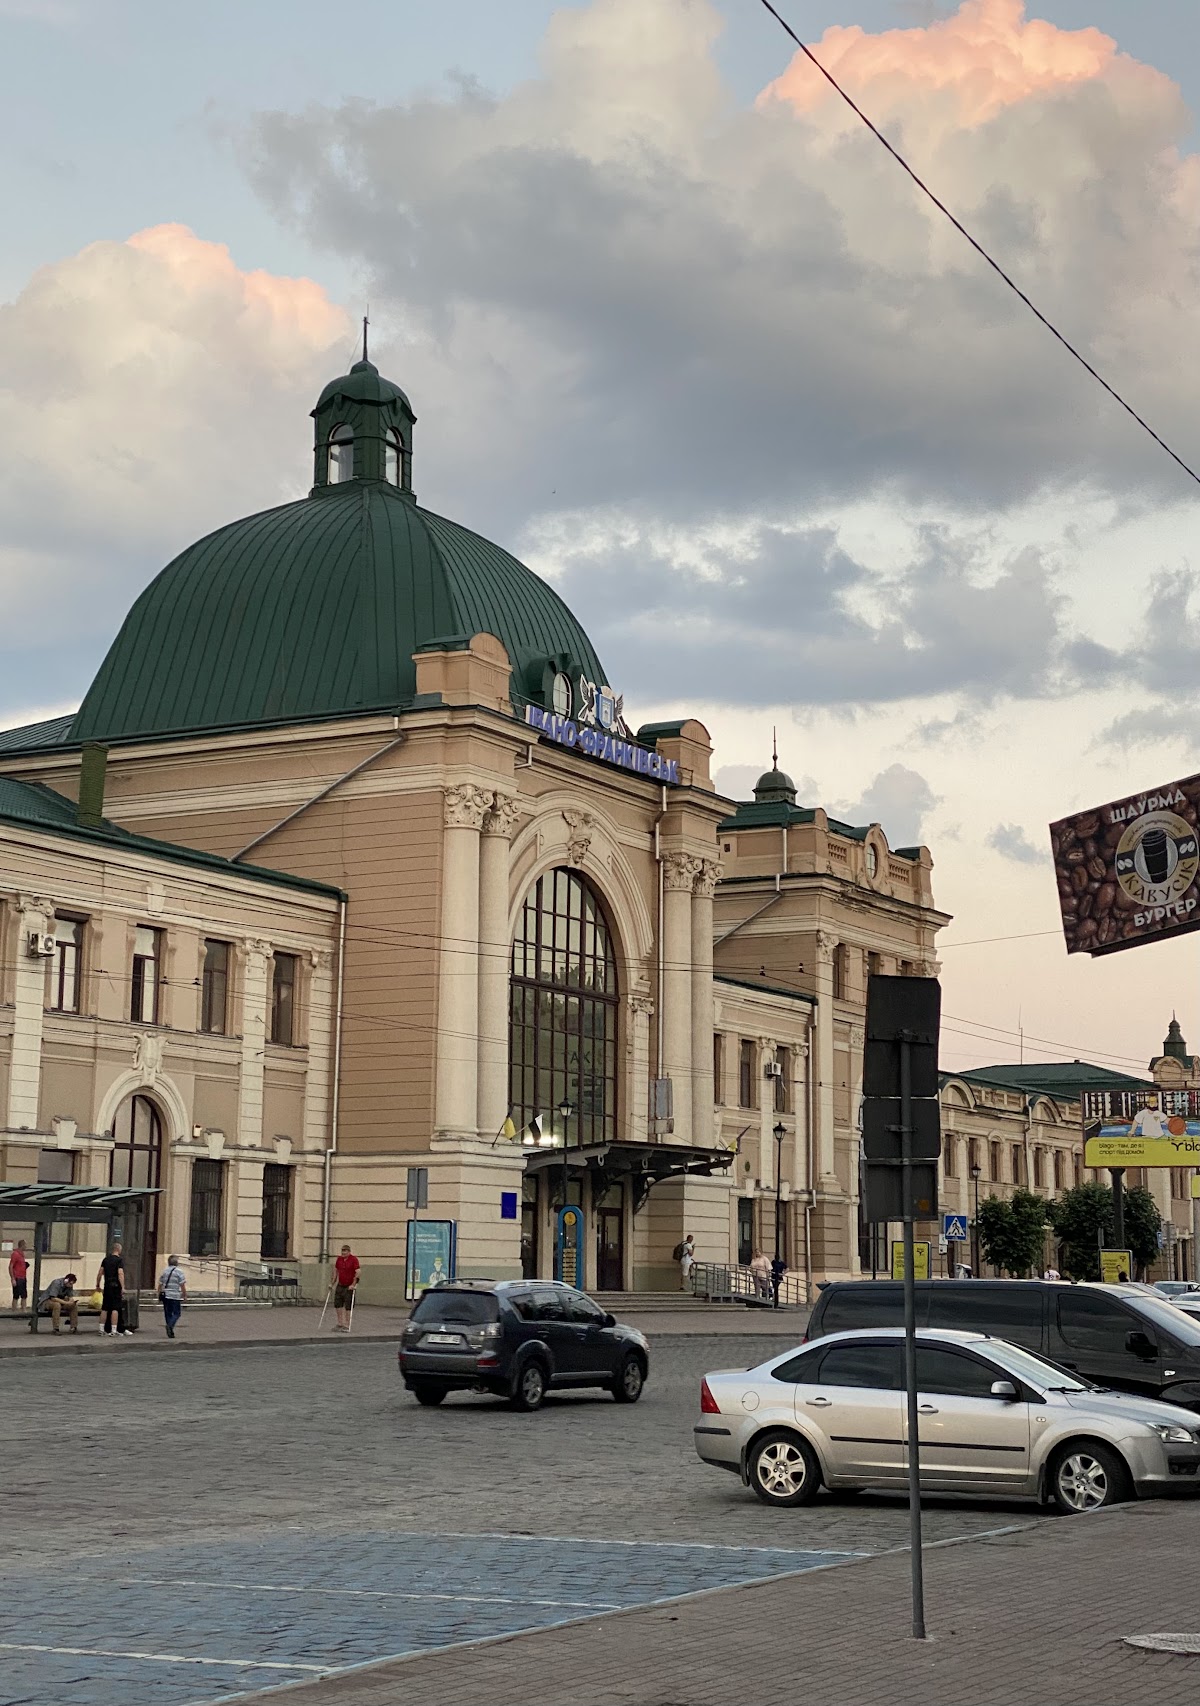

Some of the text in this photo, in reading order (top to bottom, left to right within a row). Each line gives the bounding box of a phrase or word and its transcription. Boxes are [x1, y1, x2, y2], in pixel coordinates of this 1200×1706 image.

[526, 704, 679, 784] ІВАНО-ФРАНКІВСЬК
[1110, 789, 1186, 823] ШАУРМА
[1124, 861, 1195, 903] КАВУСІК
[1133, 898, 1197, 927] БУРГЕР
